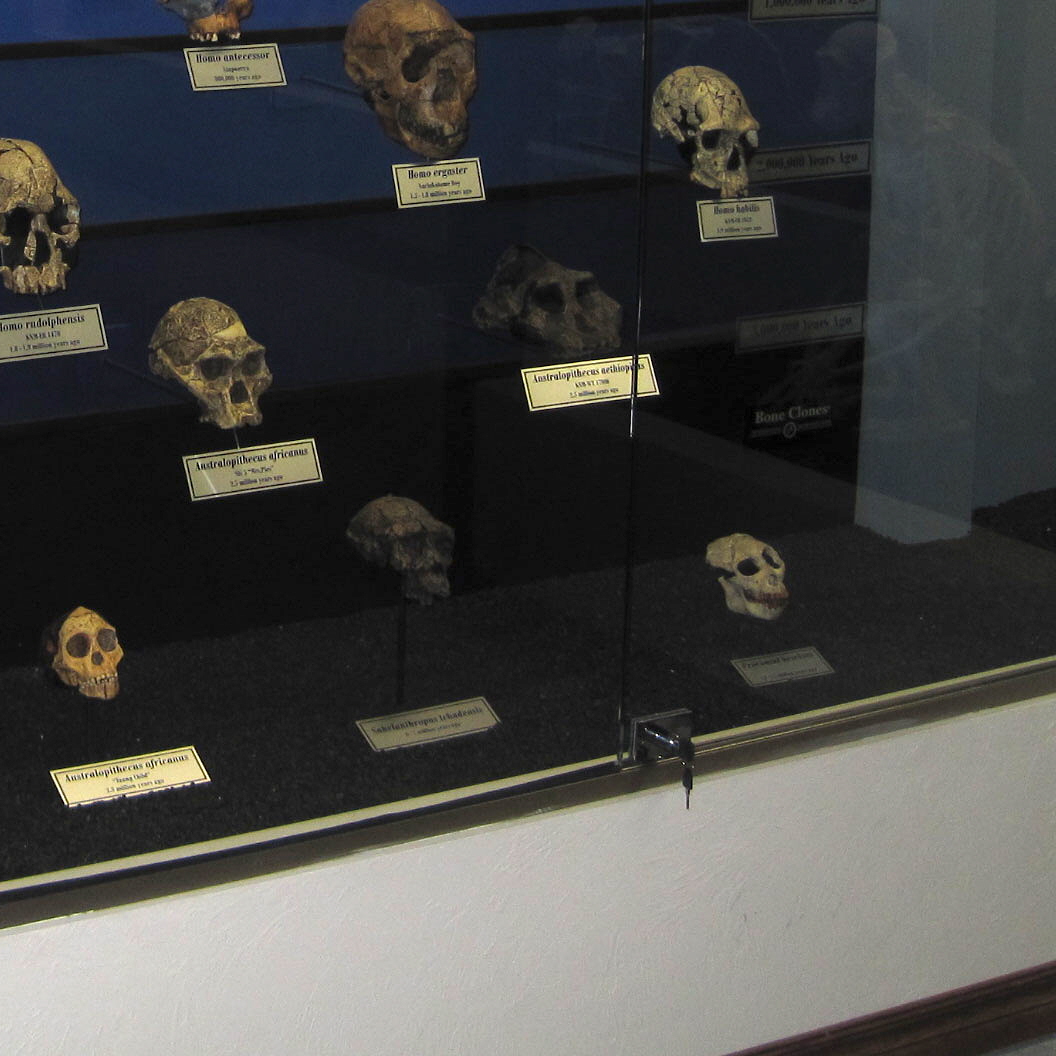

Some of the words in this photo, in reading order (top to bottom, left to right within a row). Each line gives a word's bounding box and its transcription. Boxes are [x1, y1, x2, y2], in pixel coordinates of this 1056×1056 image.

[196, 53, 221, 63] Homo
[224, 52, 270, 62] antecessor
[808, 155, 835, 167] Years
[408, 169, 431, 179] Homo
[434, 167, 468, 178] ergaster
[713, 206, 735, 214] Homo
[736, 204, 760, 213] habilis
[26, 313, 85, 329] rudolphensis
[533, 368, 600, 383] Australopithecus
[755, 410, 785, 424] Bone
[789, 405, 828, 419] Clones
[195, 453, 266, 471] Australopithecus
[269, 448, 308, 463] africanus
[65, 762, 143, 782] Australopithecus
[146, 754, 189, 770] africanus
